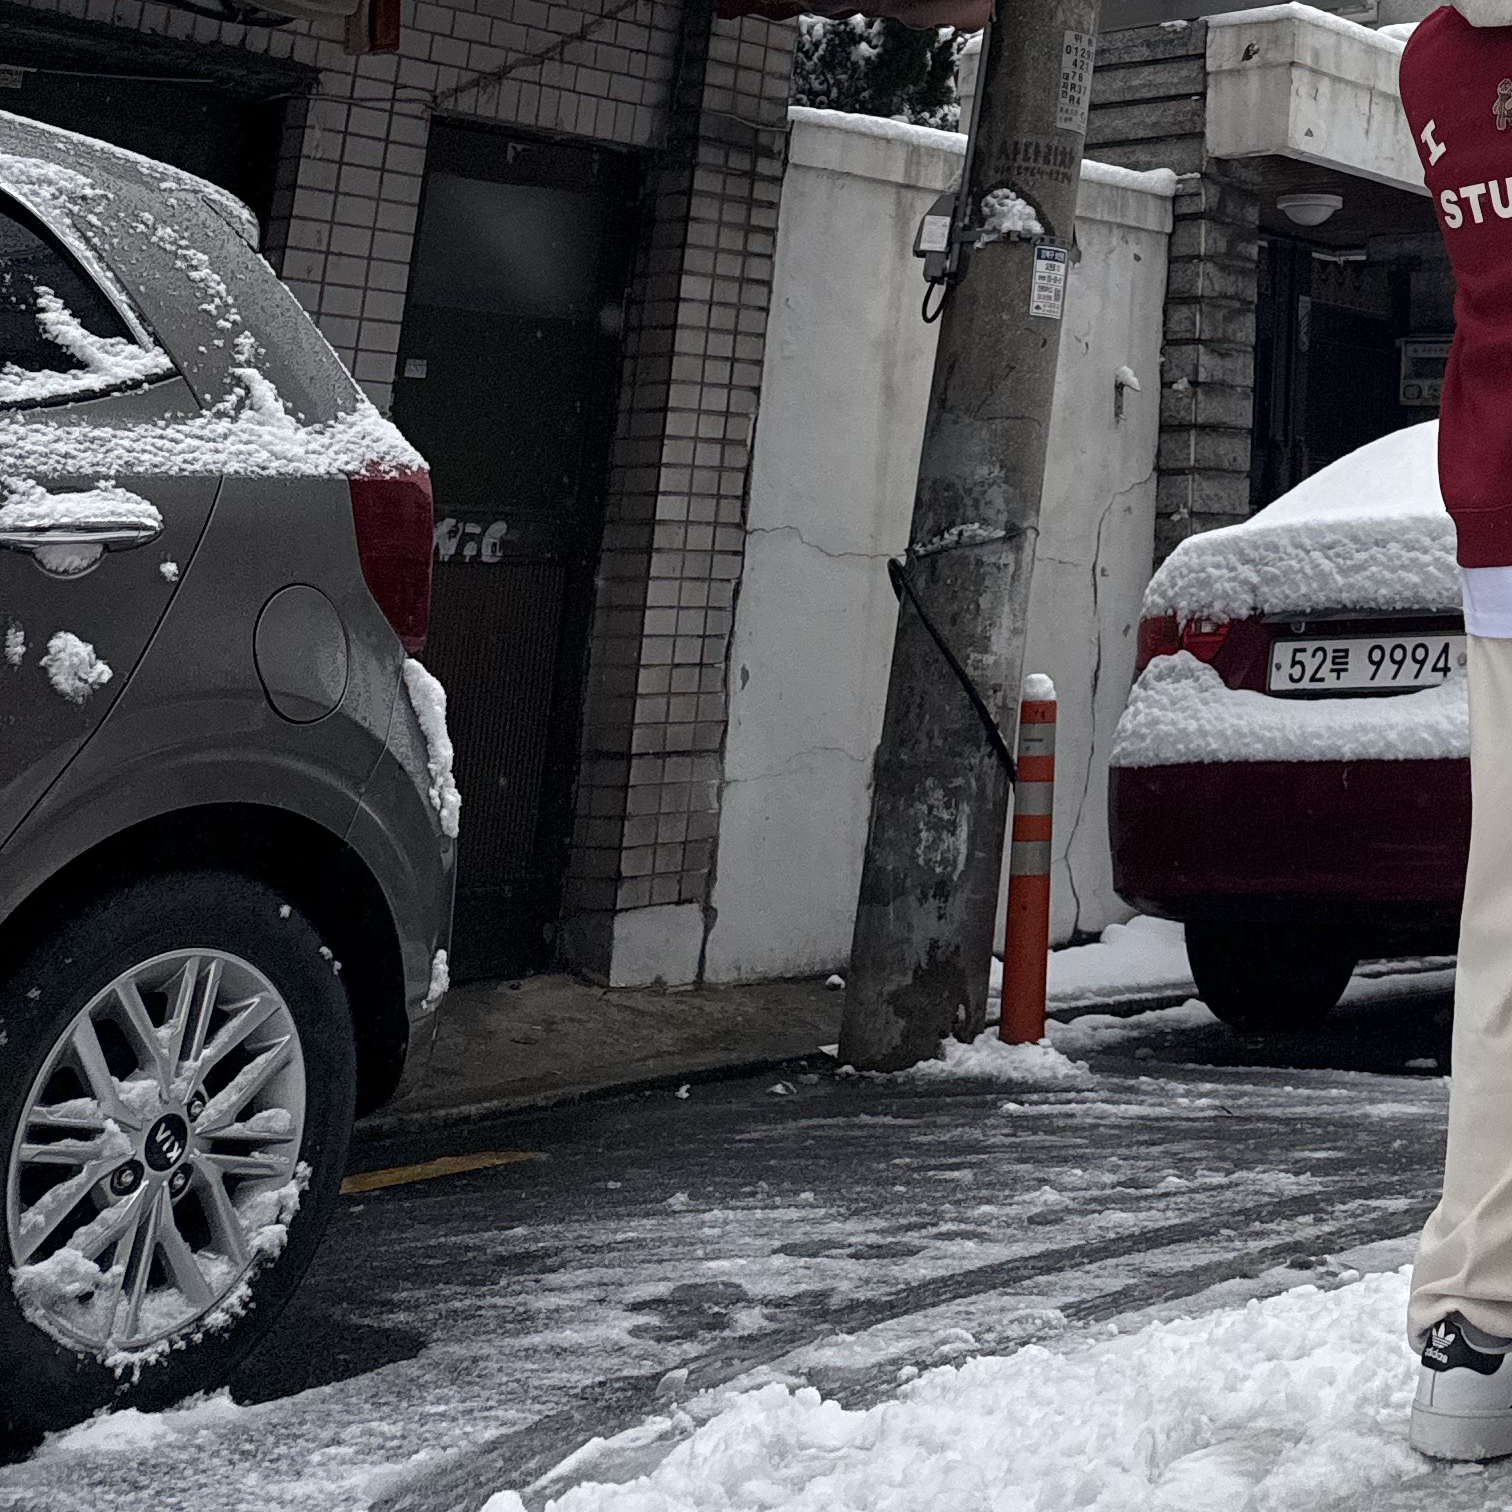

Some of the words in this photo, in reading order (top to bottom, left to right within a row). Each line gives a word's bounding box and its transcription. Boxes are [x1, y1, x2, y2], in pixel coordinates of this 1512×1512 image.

[1420, 119, 1447, 166] I
[1288, 646, 1350, 684] 52루
[1367, 642, 1452, 681] 9994
